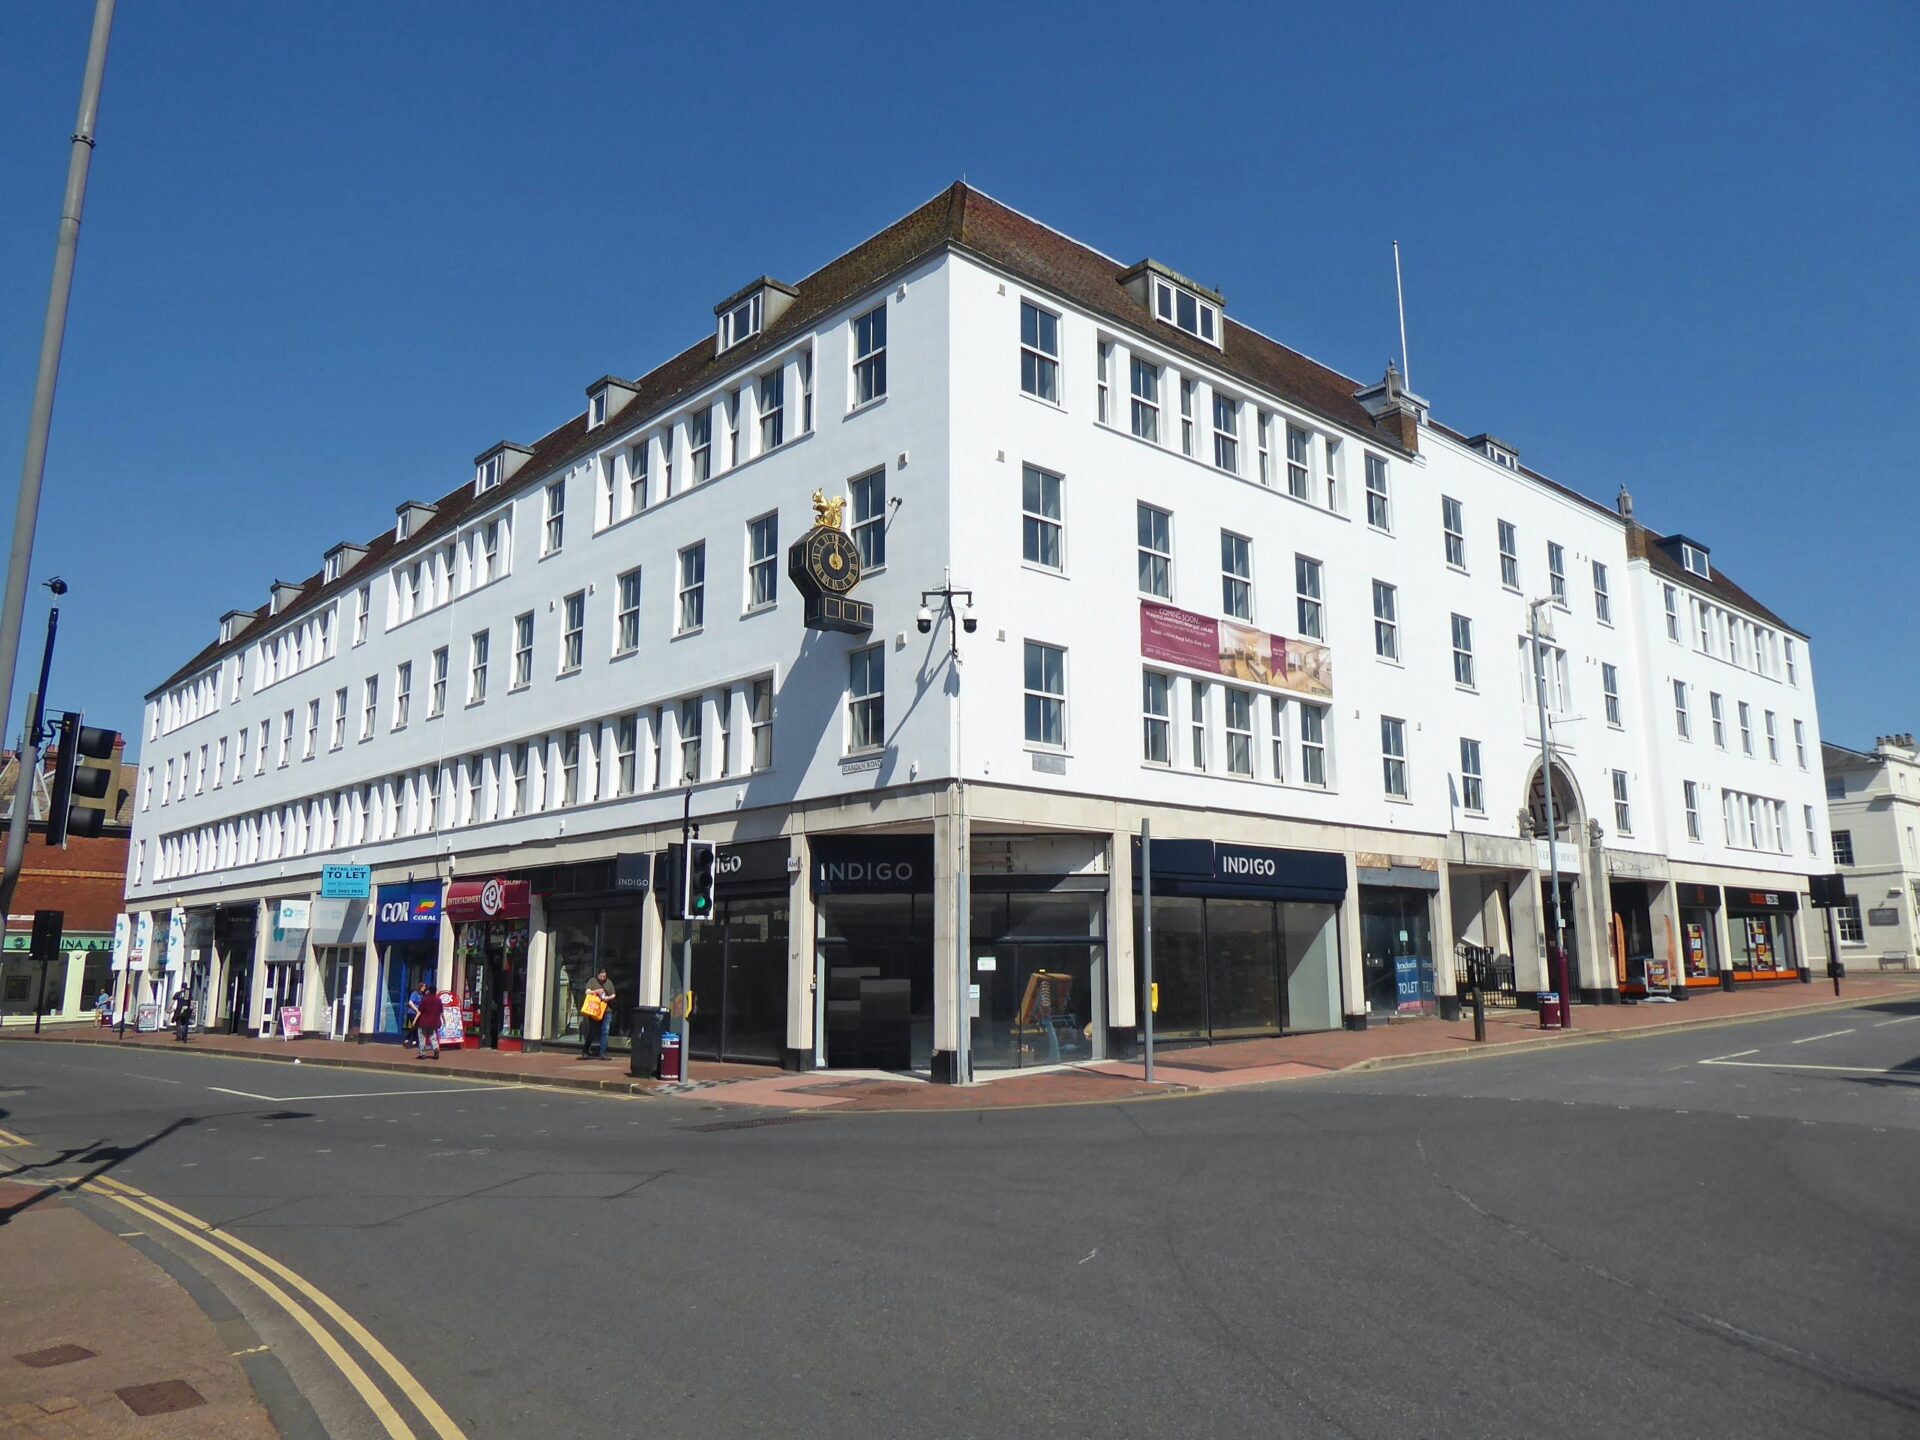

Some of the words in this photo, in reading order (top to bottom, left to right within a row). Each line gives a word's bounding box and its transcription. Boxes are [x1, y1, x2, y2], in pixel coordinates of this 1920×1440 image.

[867, 760, 881, 769] ROAD
[1223, 856, 1276, 876] INDIGO
[327, 871, 342, 879] TO
[345, 871, 366, 879] LET
[820, 862, 913, 881] INDIGO
[618, 878, 649, 887] INDIGO
[447, 895, 481, 905] ENTERTAINMENT
[1398, 982, 1407, 995] TO
[1407, 981, 1418, 993] LET
